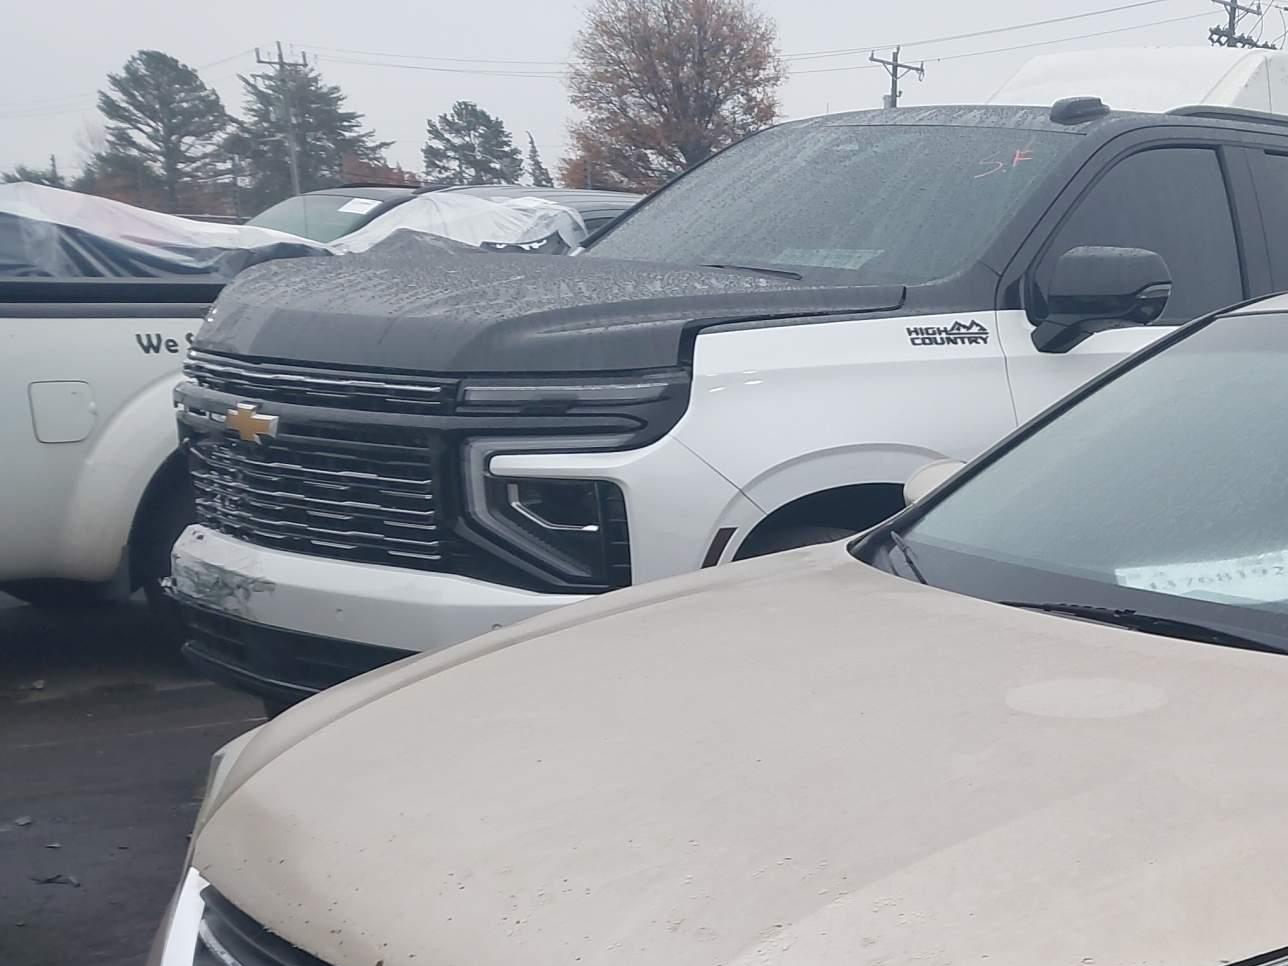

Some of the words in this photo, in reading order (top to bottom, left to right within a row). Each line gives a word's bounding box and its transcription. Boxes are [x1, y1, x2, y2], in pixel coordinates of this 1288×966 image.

[906, 327, 948, 336] HIGH
[135, 333, 179, 354] We
[910, 336, 989, 346] COUNTRY
